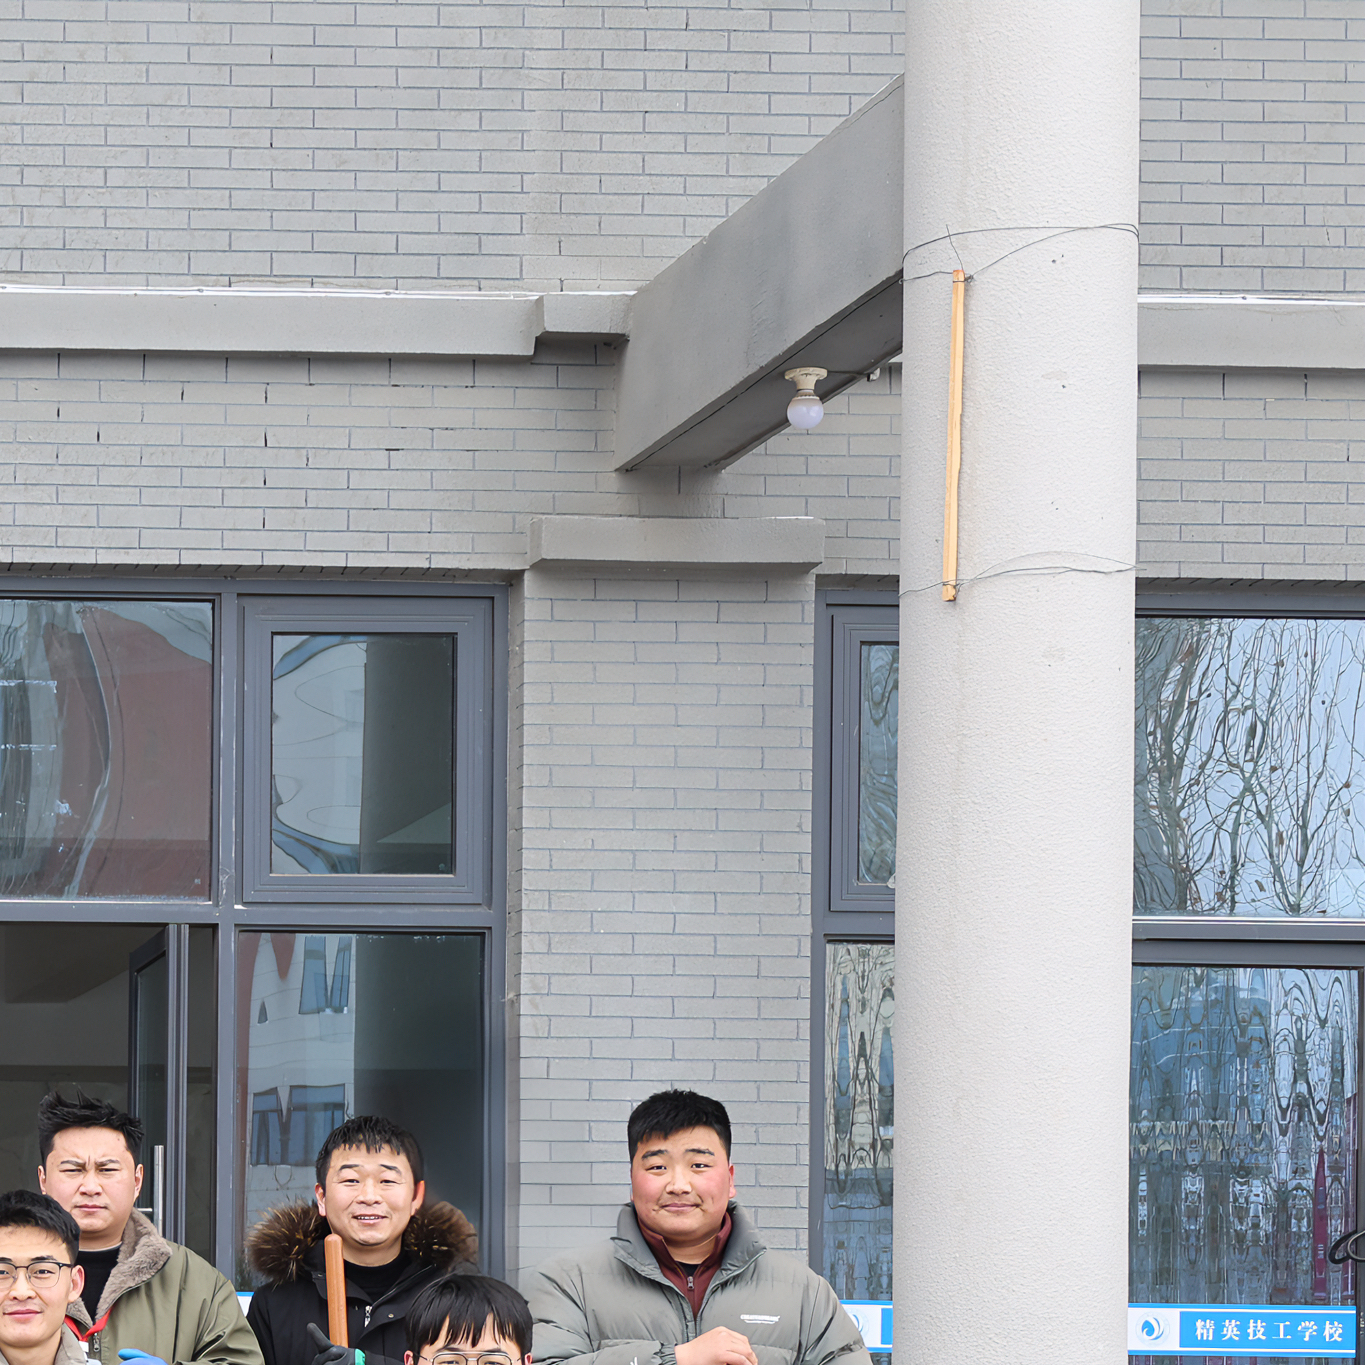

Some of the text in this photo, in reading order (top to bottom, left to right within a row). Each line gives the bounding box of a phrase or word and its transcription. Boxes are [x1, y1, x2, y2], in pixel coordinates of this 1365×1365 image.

[1195, 1318, 1343, 1342] 精英技工学校
